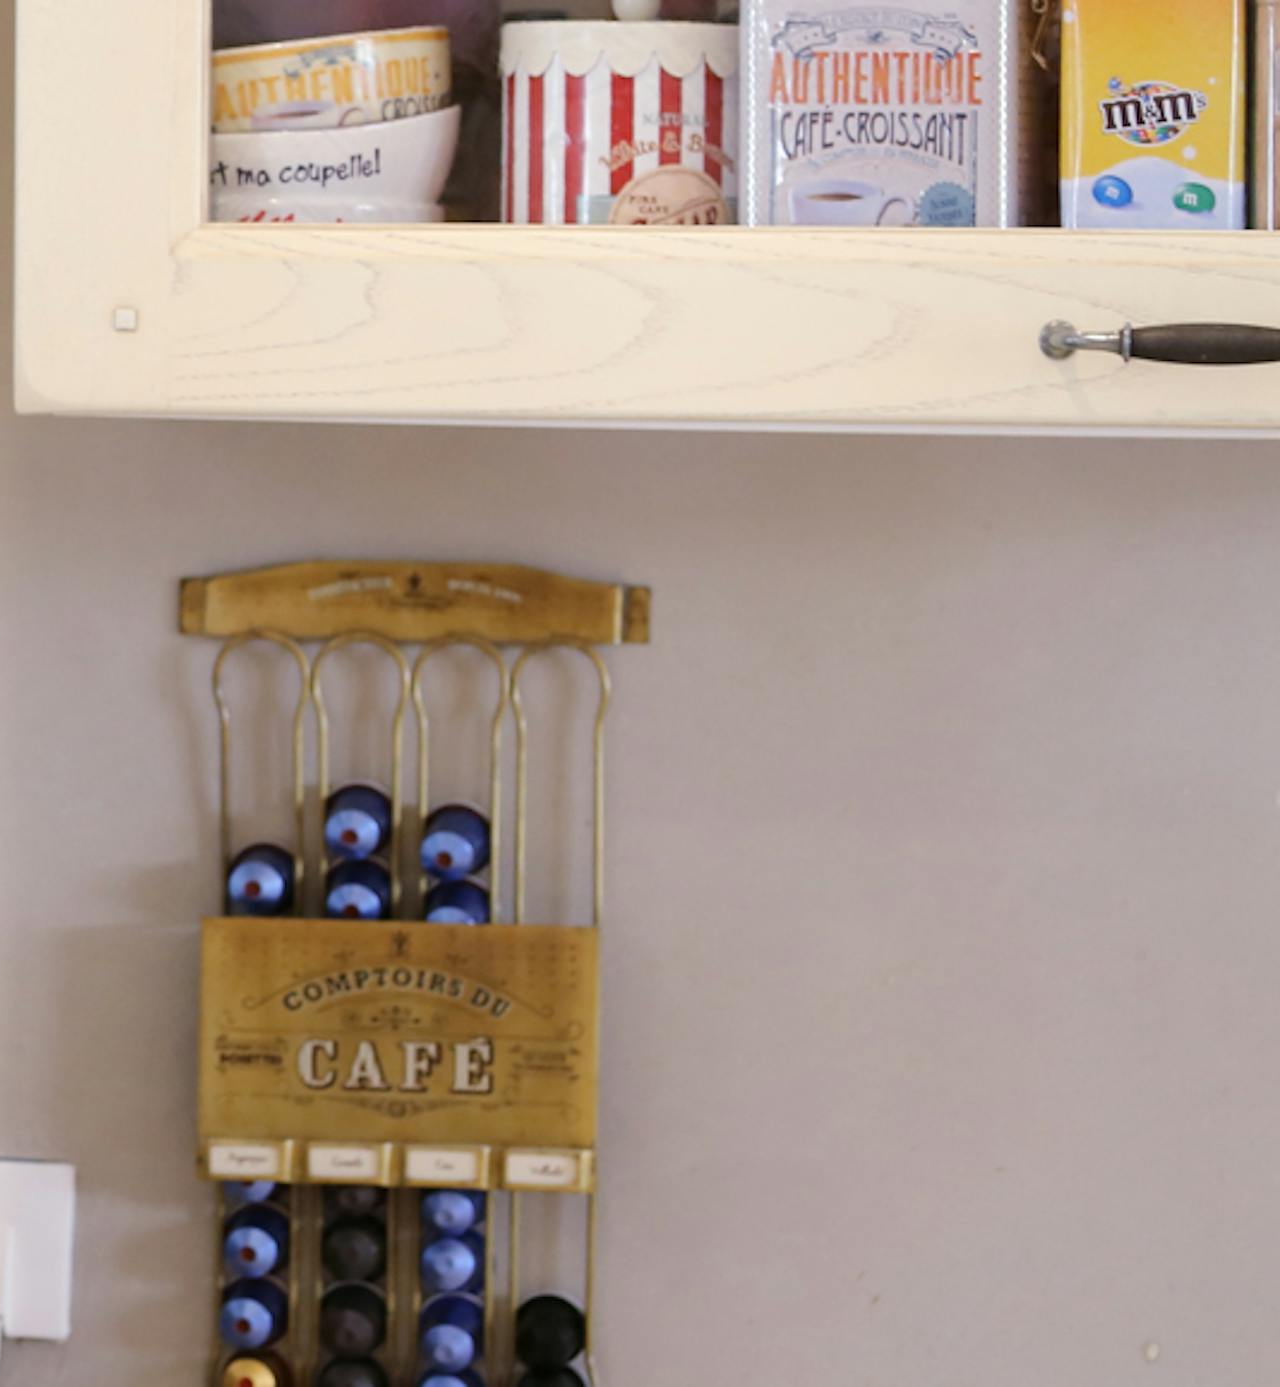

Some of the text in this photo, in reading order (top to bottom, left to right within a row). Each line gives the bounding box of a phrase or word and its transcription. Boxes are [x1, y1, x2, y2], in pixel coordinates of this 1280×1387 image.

[769, 51, 983, 105] AUTHENTIQUE
[237, 166, 272, 188] ma
[279, 147, 381, 188] coupelle!
[282, 966, 511, 1020] COMPTOIRS DU
[297, 1036, 495, 1094] CAFÉ
